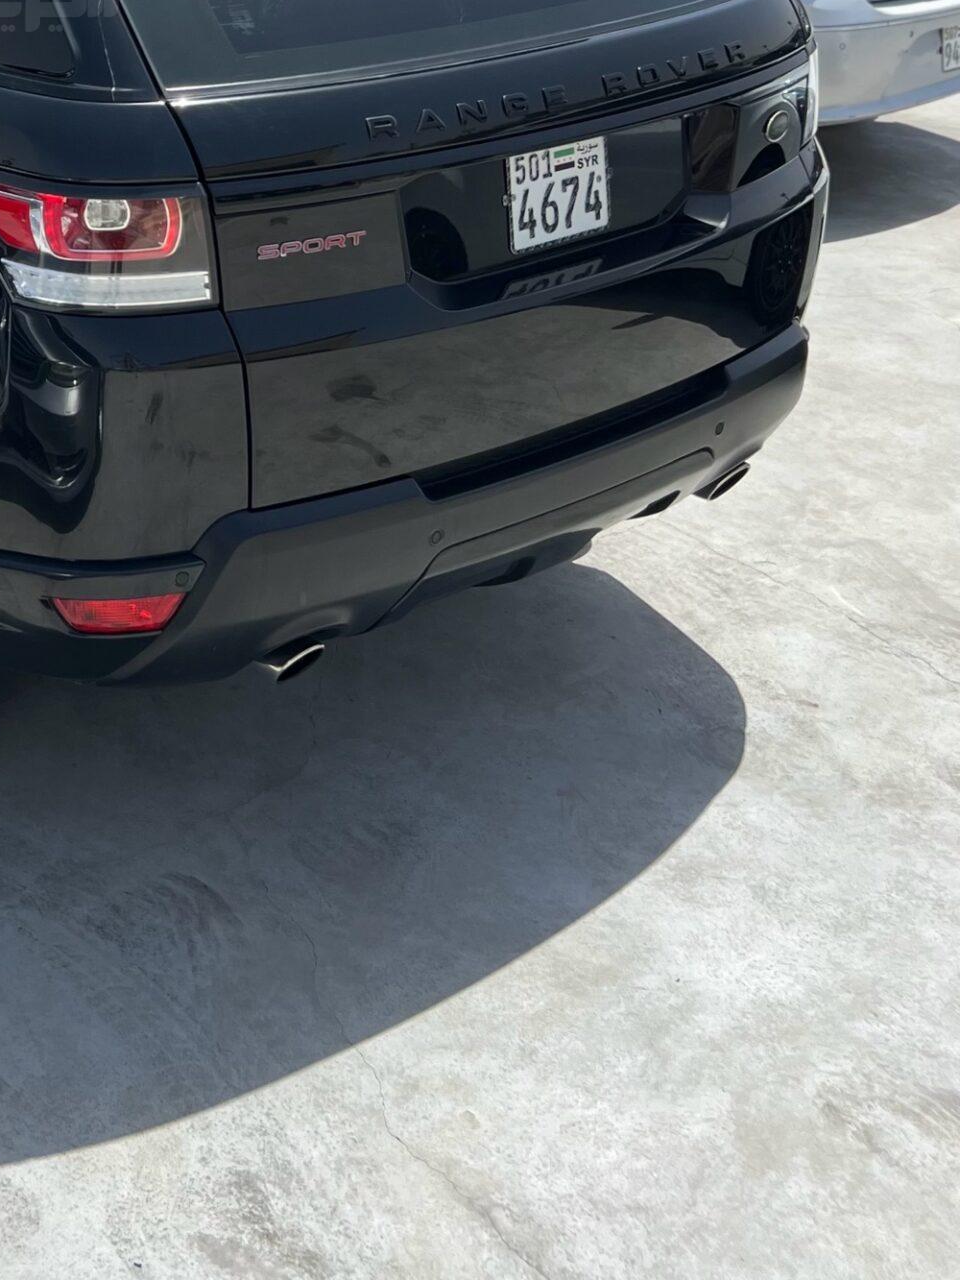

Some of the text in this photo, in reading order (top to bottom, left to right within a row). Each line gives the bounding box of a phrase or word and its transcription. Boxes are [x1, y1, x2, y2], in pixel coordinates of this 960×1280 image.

[366, 43, 747, 142] RANGE ROVER
[515, 150, 552, 185] 501
[577, 154, 599, 169] SYR
[519, 171, 602, 238] 4674
[257, 230, 367, 261] SPORT
